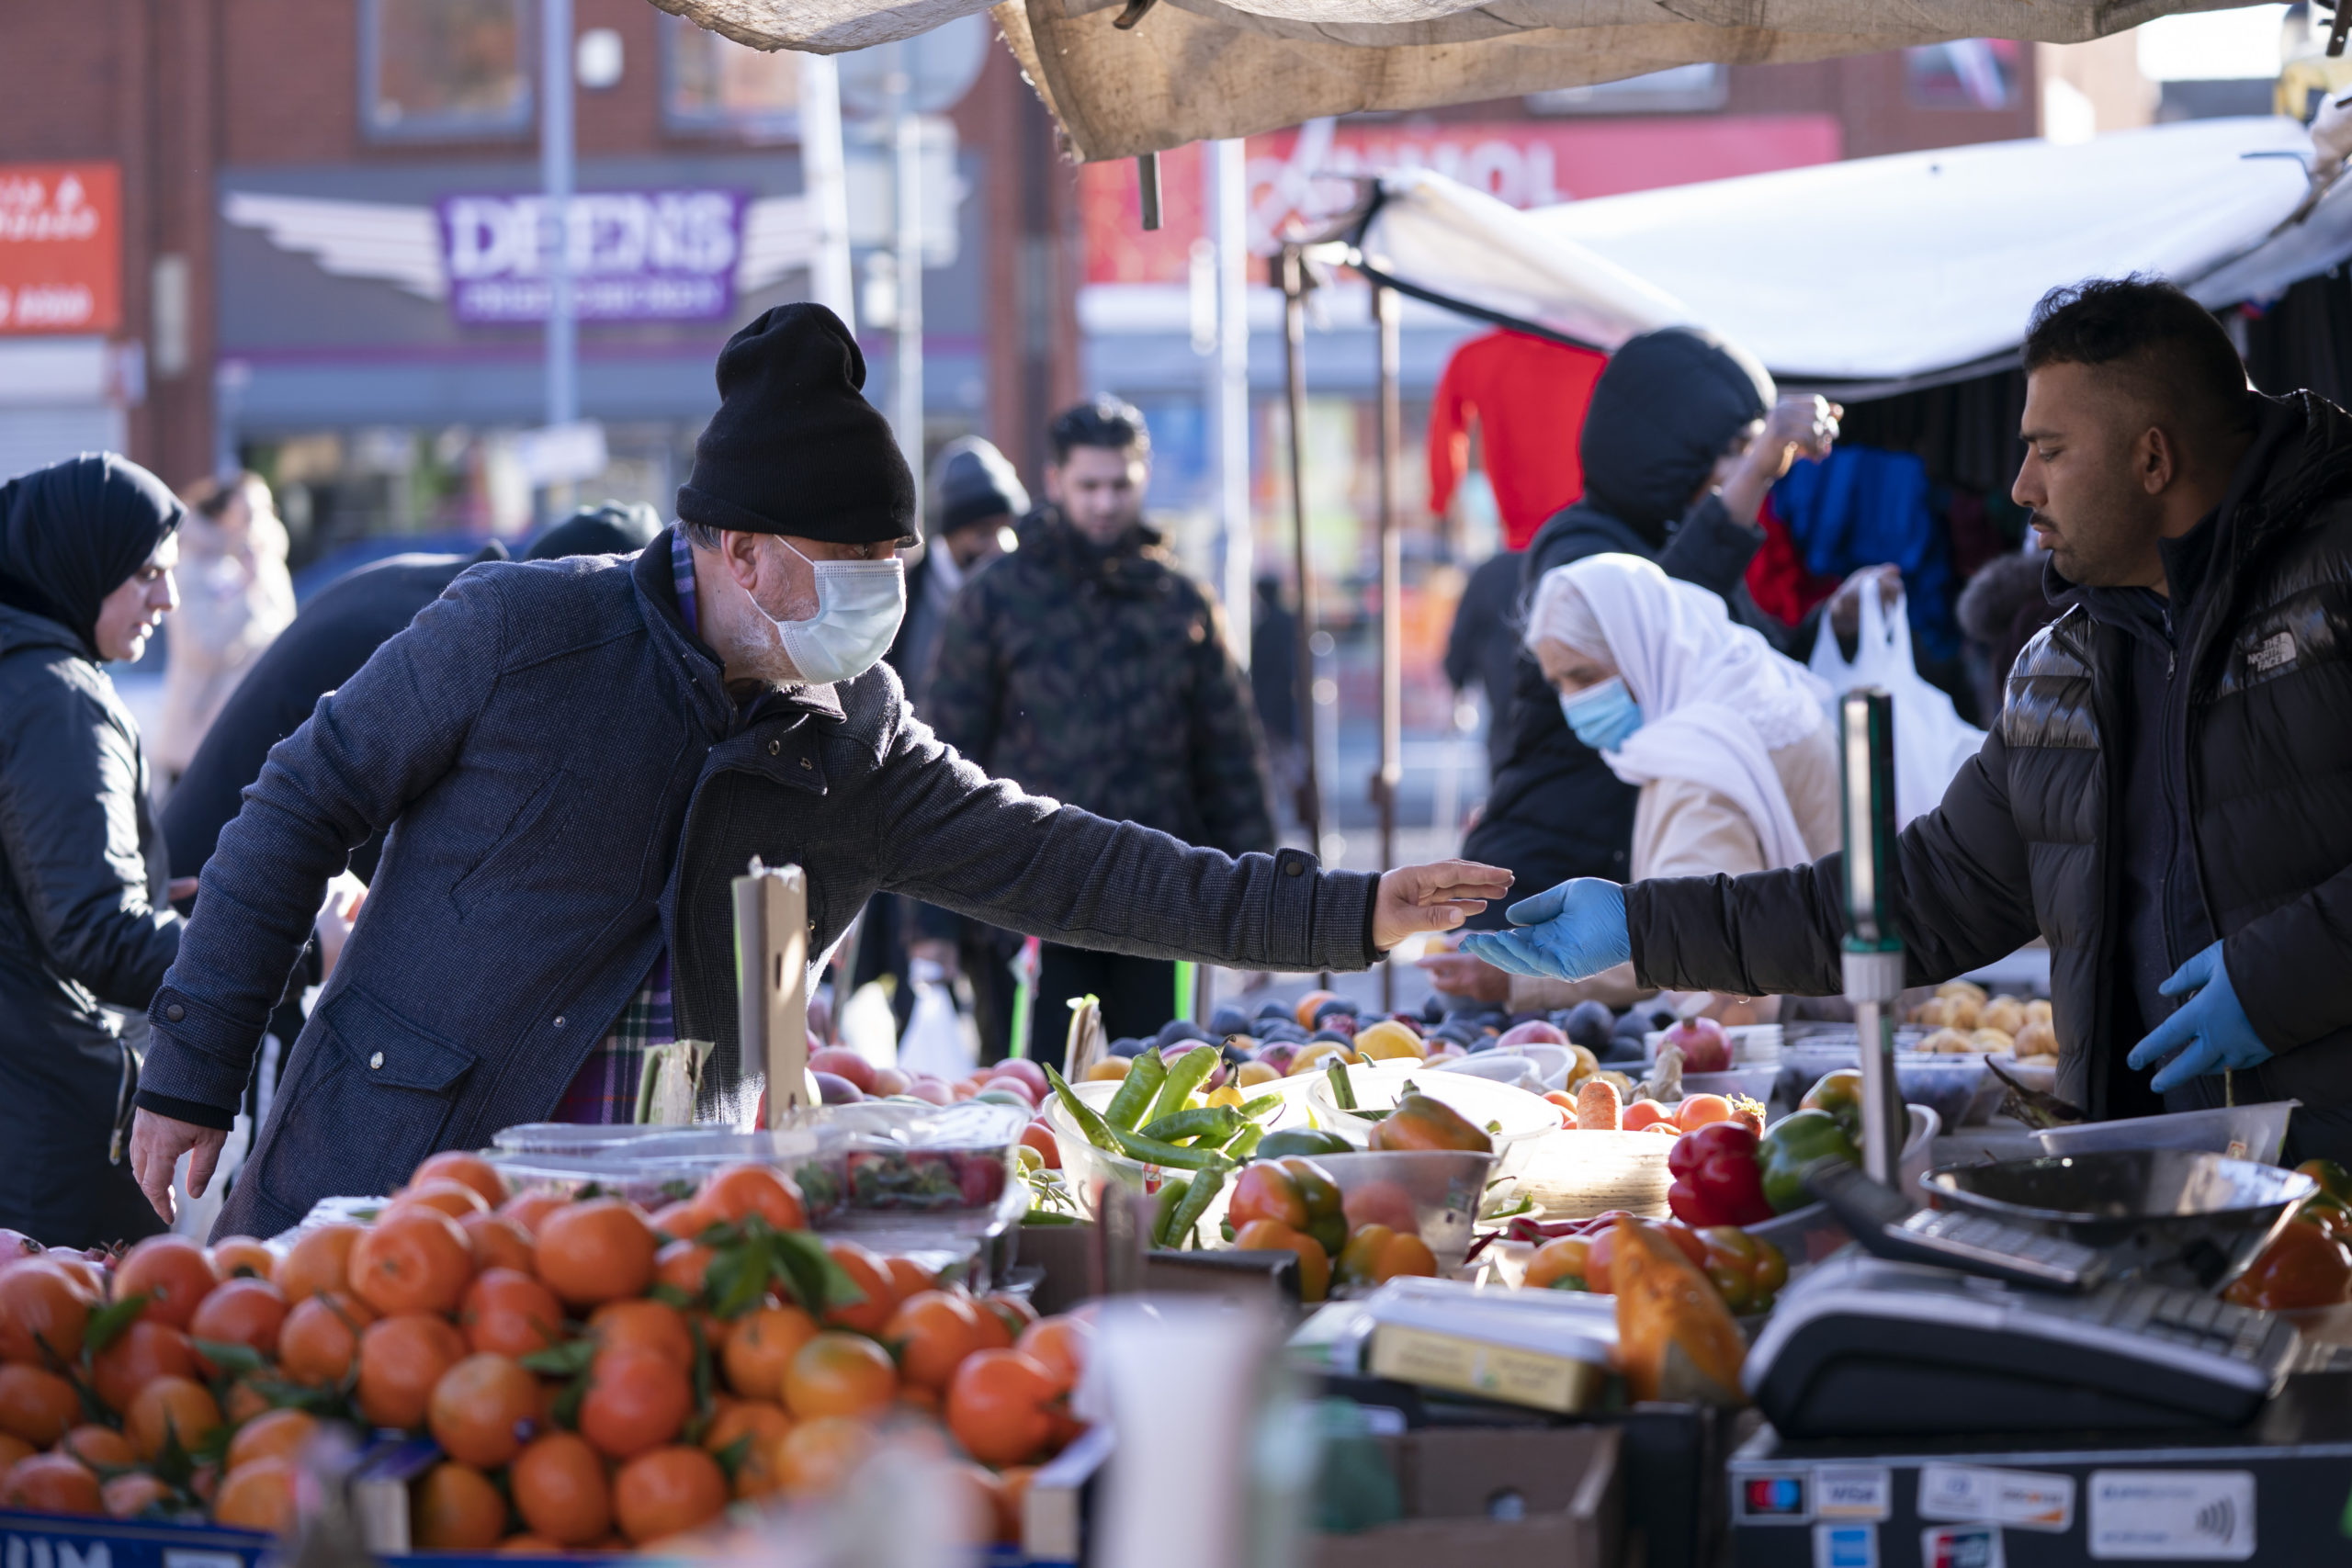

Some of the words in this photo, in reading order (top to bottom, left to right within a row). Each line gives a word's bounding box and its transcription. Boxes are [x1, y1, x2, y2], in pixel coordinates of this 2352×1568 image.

[2264, 633, 2281, 652] THE
[2247, 643, 2282, 665] NORTH
[2257, 655, 2283, 672] FACE
